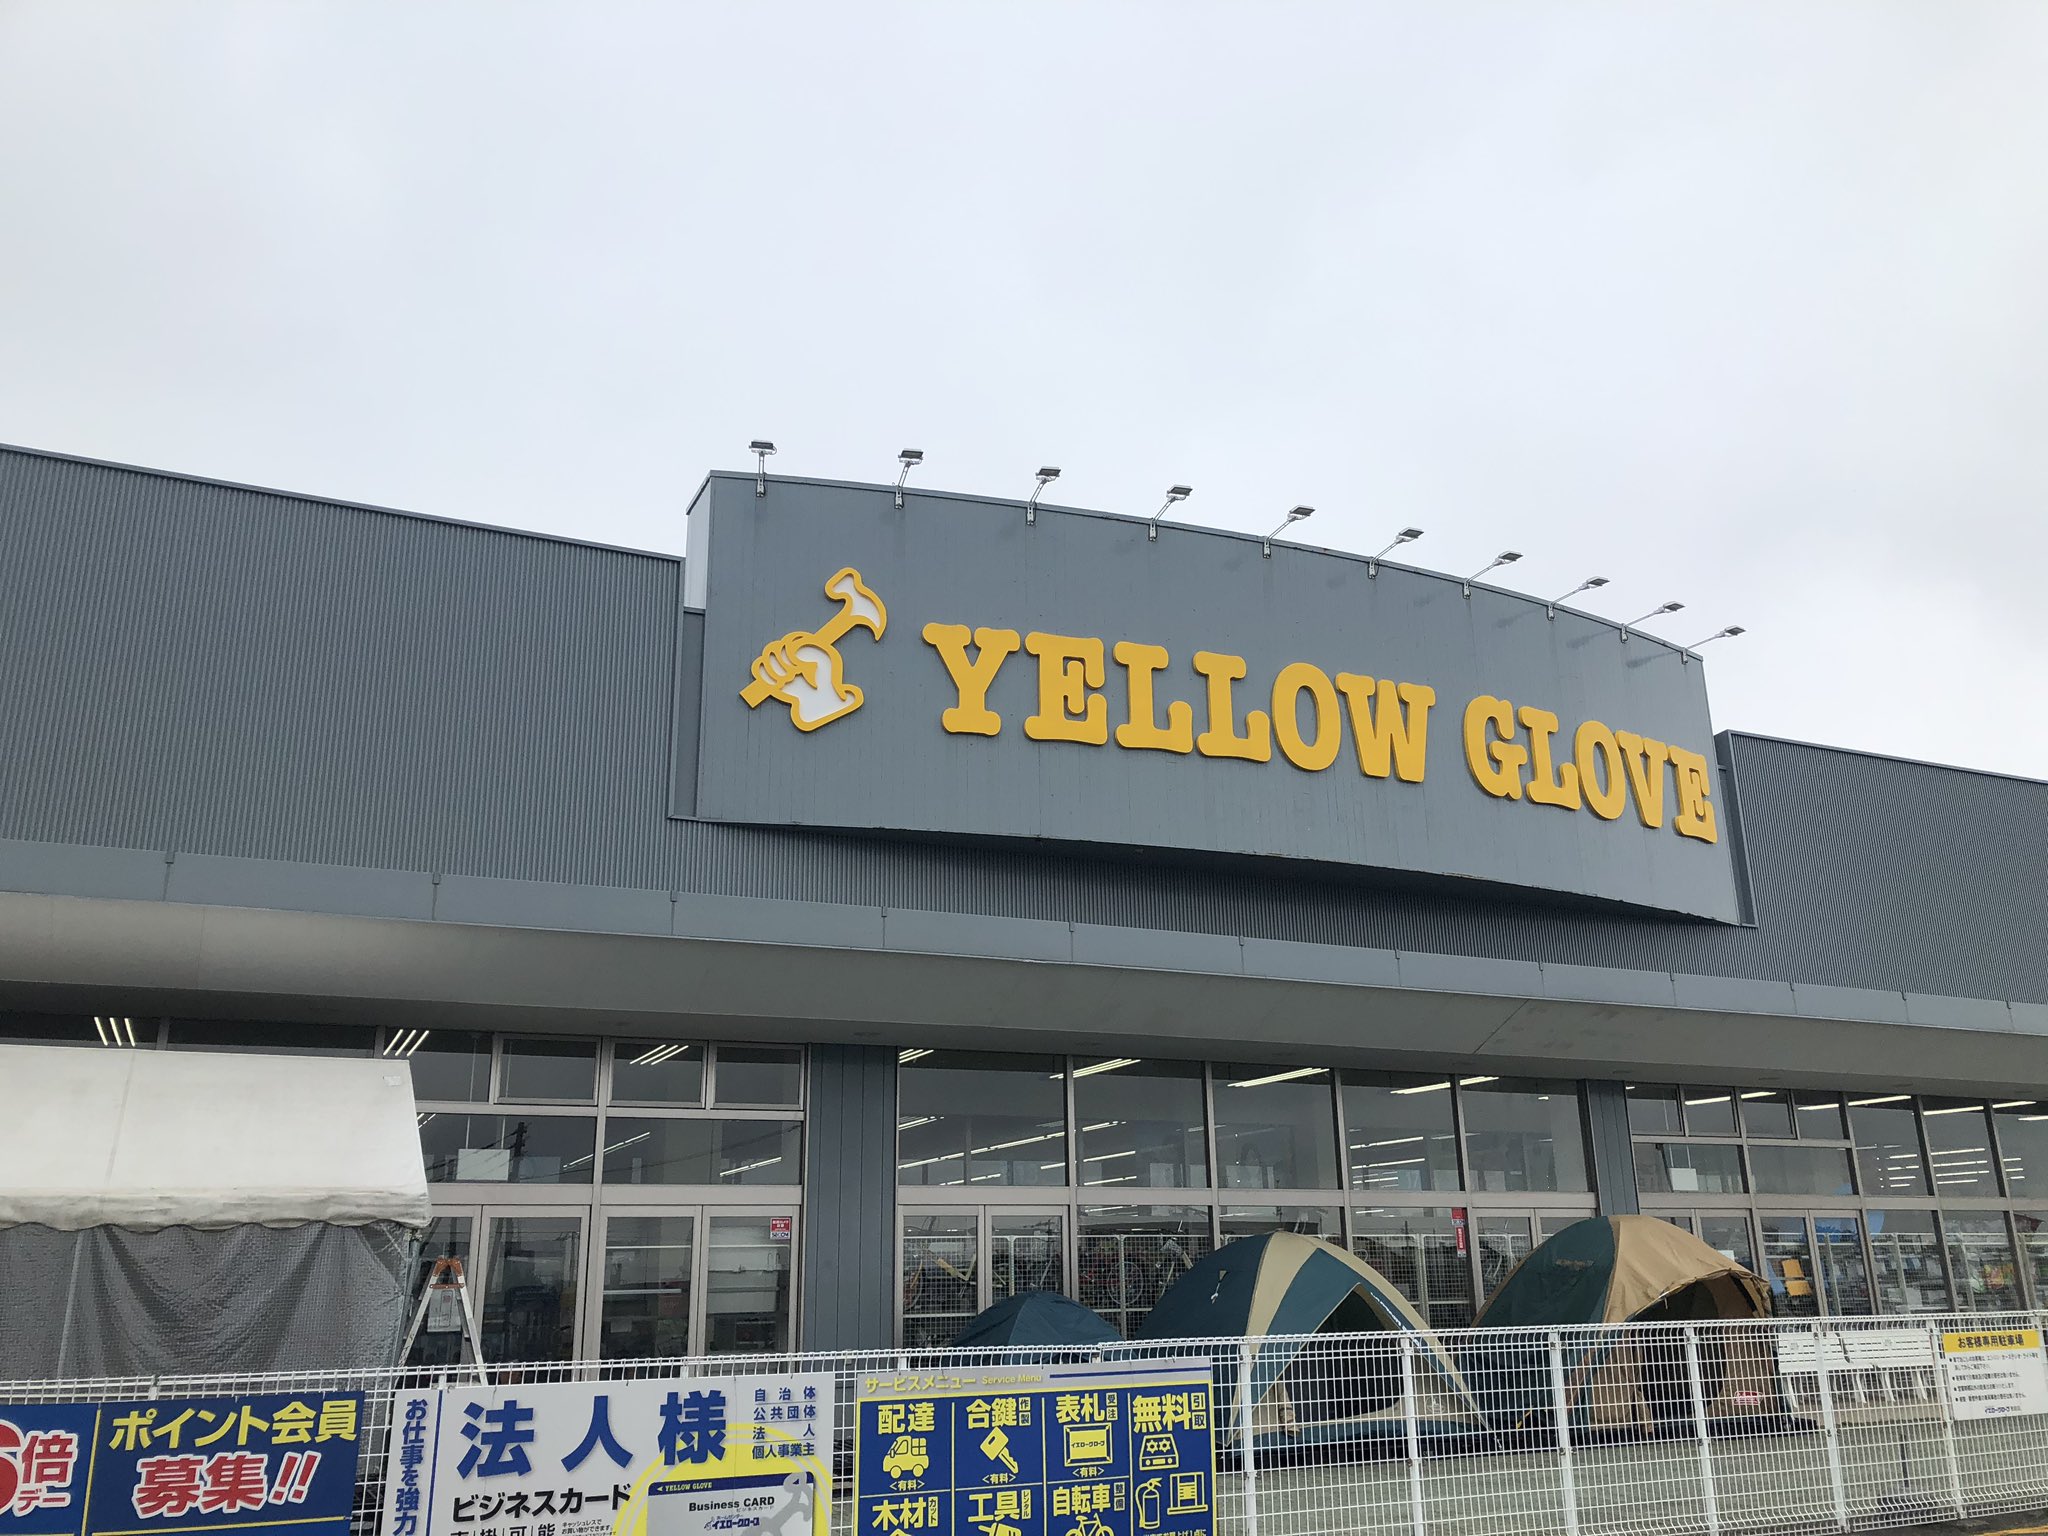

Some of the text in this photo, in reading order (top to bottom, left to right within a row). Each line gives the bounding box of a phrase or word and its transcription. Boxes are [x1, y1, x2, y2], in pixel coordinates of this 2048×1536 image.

[922, 622, 1718, 844] YELLOW GLOVE
[1958, 1334, 2024, 1349] お客様専用駐車場
[754, 1386, 816, 1402] 自治体
[865, 1373, 1042, 1394] サービスメニュー Service Menu
[753, 1404, 816, 1421] 公共団体
[877, 1401, 936, 1435] 配達
[966, 1397, 1018, 1430] 合鍵
[1056, 1393, 1105, 1424] 表札
[1107, 1394, 1117, 1419] 受注
[1132, 1392, 1192, 1434] 無料
[1193, 1394, 1205, 1428] 引取
[108, 1399, 358, 1452] ポイント会員
[456, 1389, 727, 1481] 法人様
[752, 1423, 815, 1440] 法人
[751, 1441, 816, 1460] 個人事業主
[392, 1398, 428, 1536] お仕事を強力
[453, 1483, 631, 1522] ビジネスカード
[664, 1484, 690, 1492] YELLOW
[689, 1496, 775, 1512] Business CARD
[1053, 1483, 1111, 1517] 自転車
[872, 1497, 926, 1531] 木材
[929, 1499, 937, 1525] カット
[968, 1490, 1020, 1522] 工具
